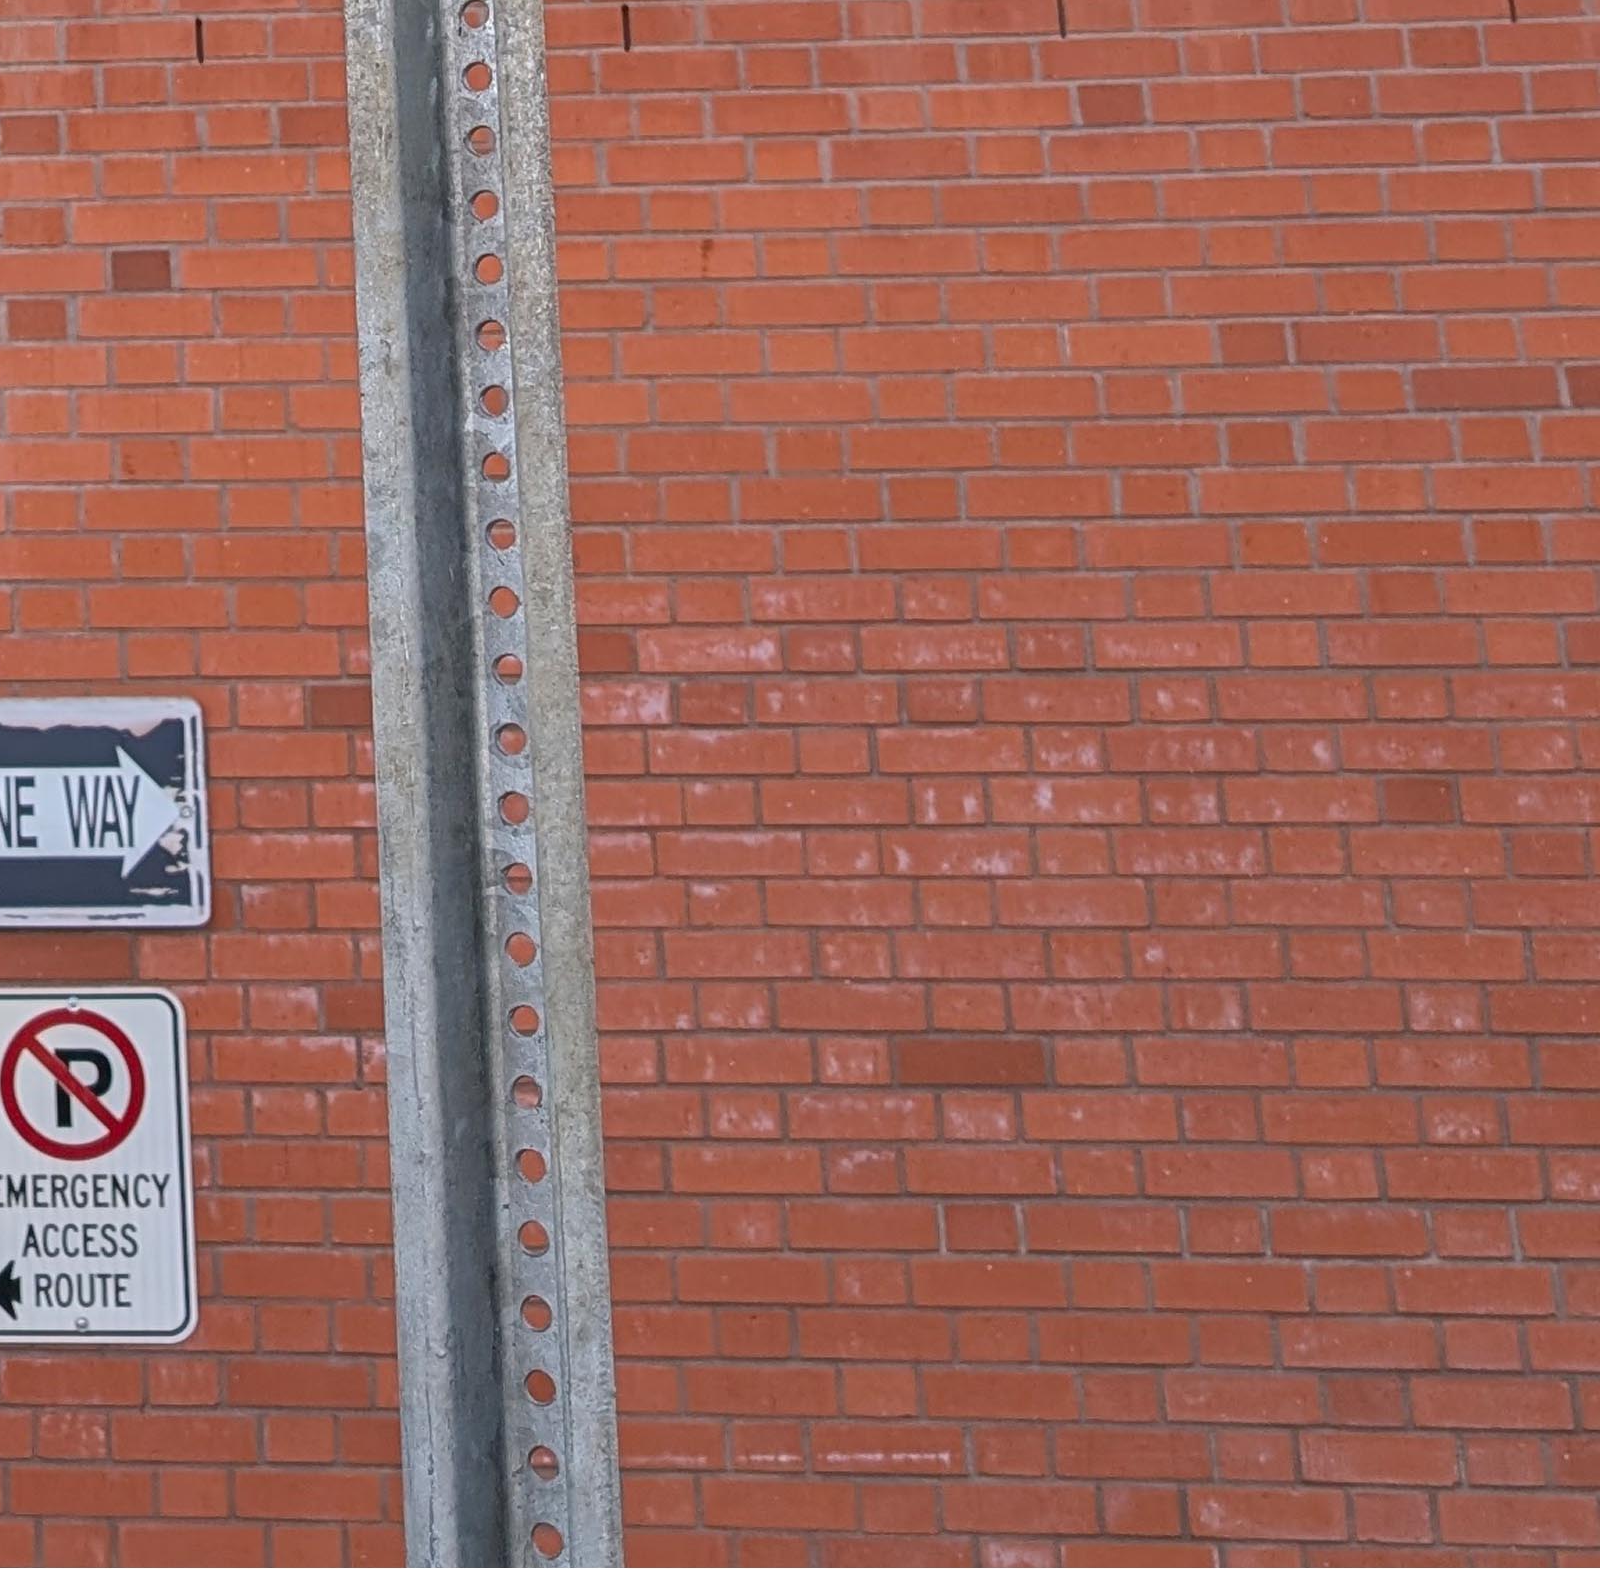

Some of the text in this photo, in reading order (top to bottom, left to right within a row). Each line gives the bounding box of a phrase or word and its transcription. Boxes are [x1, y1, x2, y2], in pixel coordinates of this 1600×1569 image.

[63, 773, 141, 849] WAY
[54, 1046, 113, 1128] P
[21, 1223, 140, 1259] ACCESS
[33, 1273, 132, 1309] ROUTE
